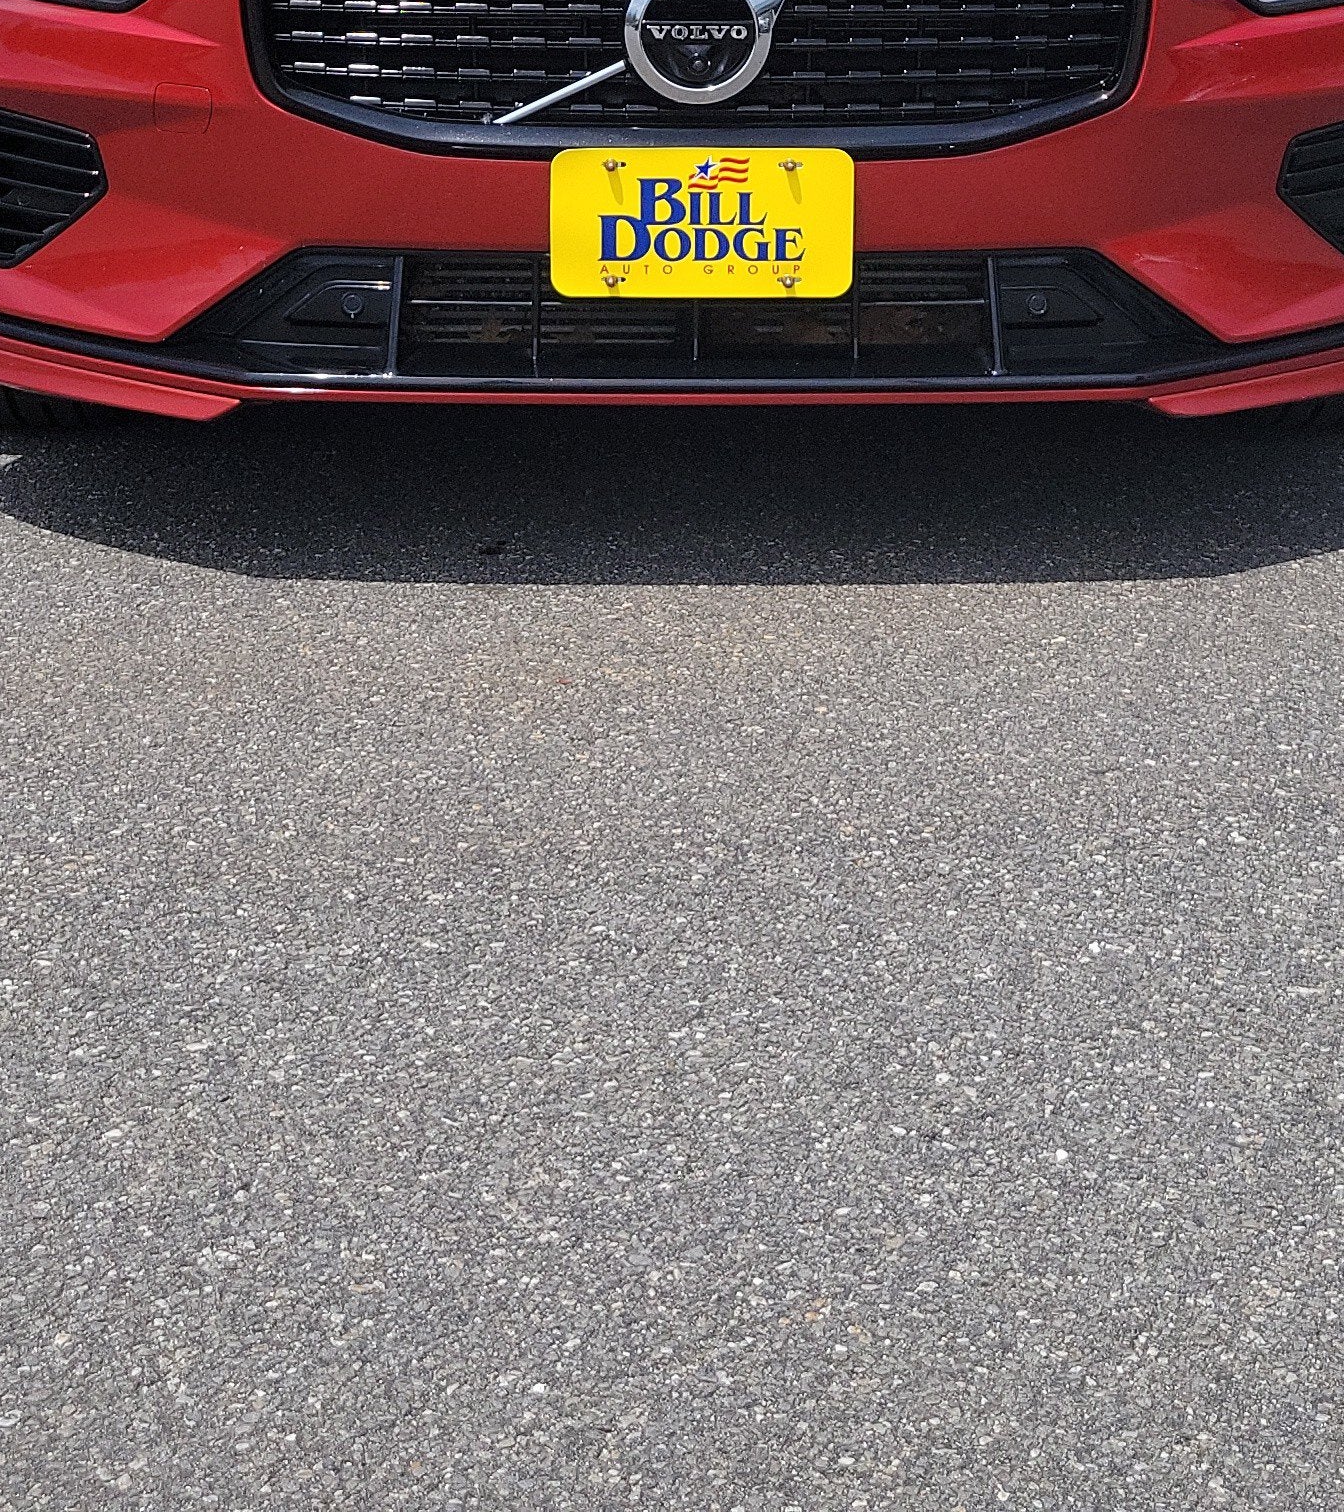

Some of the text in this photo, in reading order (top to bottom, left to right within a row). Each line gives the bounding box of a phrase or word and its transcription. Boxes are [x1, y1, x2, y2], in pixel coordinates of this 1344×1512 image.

[646, 25, 749, 41] VOLVO
[637, 177, 768, 226] BILL
[598, 214, 806, 263] DODGE
[600, 264, 801, 276] AUTO GROUP
